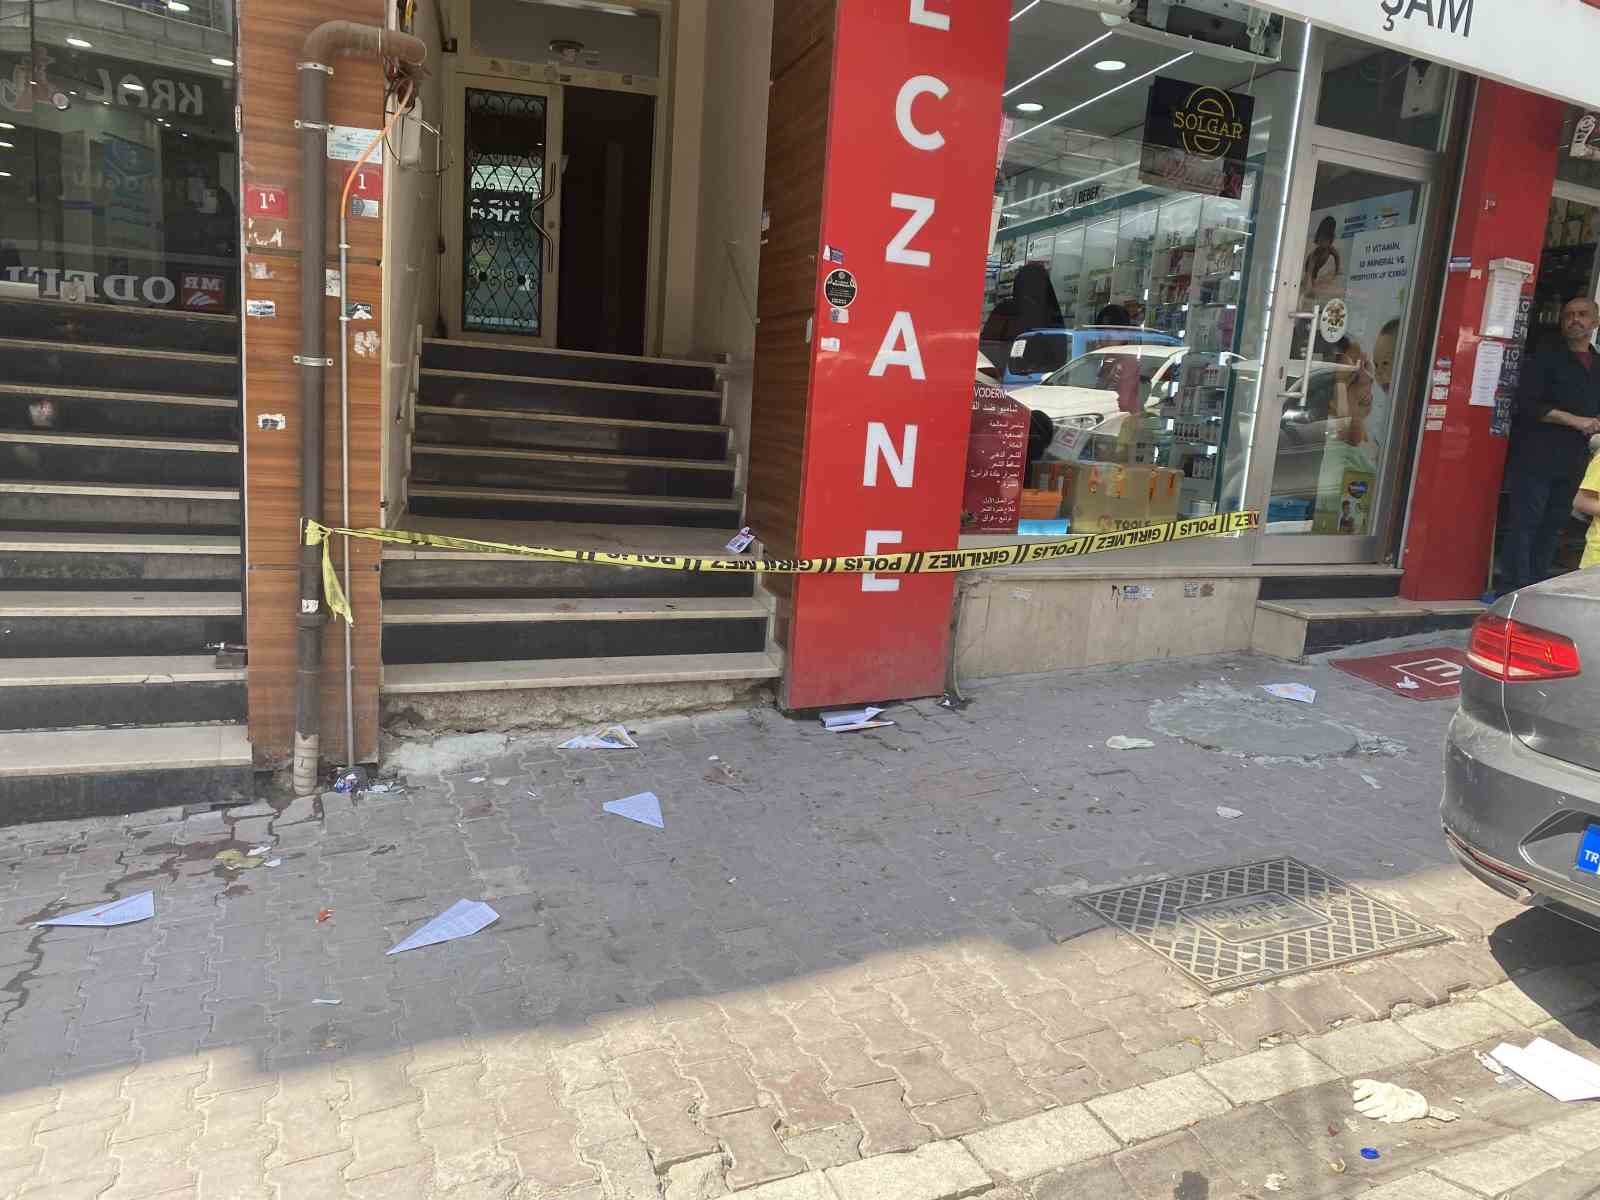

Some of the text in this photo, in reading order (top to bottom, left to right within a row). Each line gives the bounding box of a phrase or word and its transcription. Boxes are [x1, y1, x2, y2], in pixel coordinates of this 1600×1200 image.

[1173, 111, 1243, 140] SOLGAR
[358, 173, 367, 190] 1
[1584, 849, 1600, 864] TR
